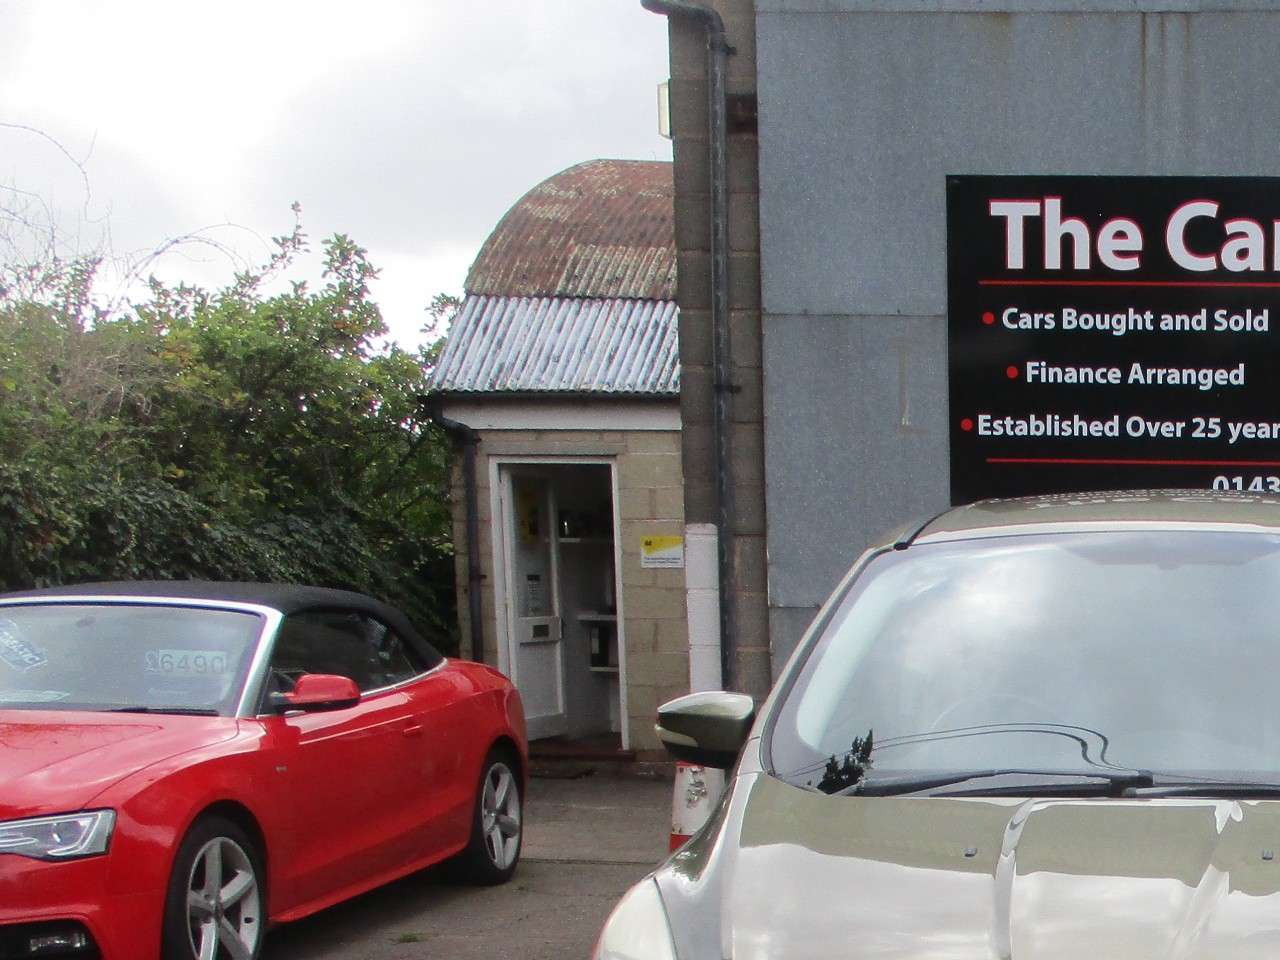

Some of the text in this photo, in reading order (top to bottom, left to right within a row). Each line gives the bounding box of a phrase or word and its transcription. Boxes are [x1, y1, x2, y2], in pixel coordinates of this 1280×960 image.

[989, 198, 1143, 271] The
[1002, 307, 1269, 336] Cars Bought and Sold
[1026, 361, 1246, 391] Finance Arranged
[977, 413, 1120, 438] Established
[1125, 415, 1186, 438] Over
[1191, 417, 1222, 439] 25
